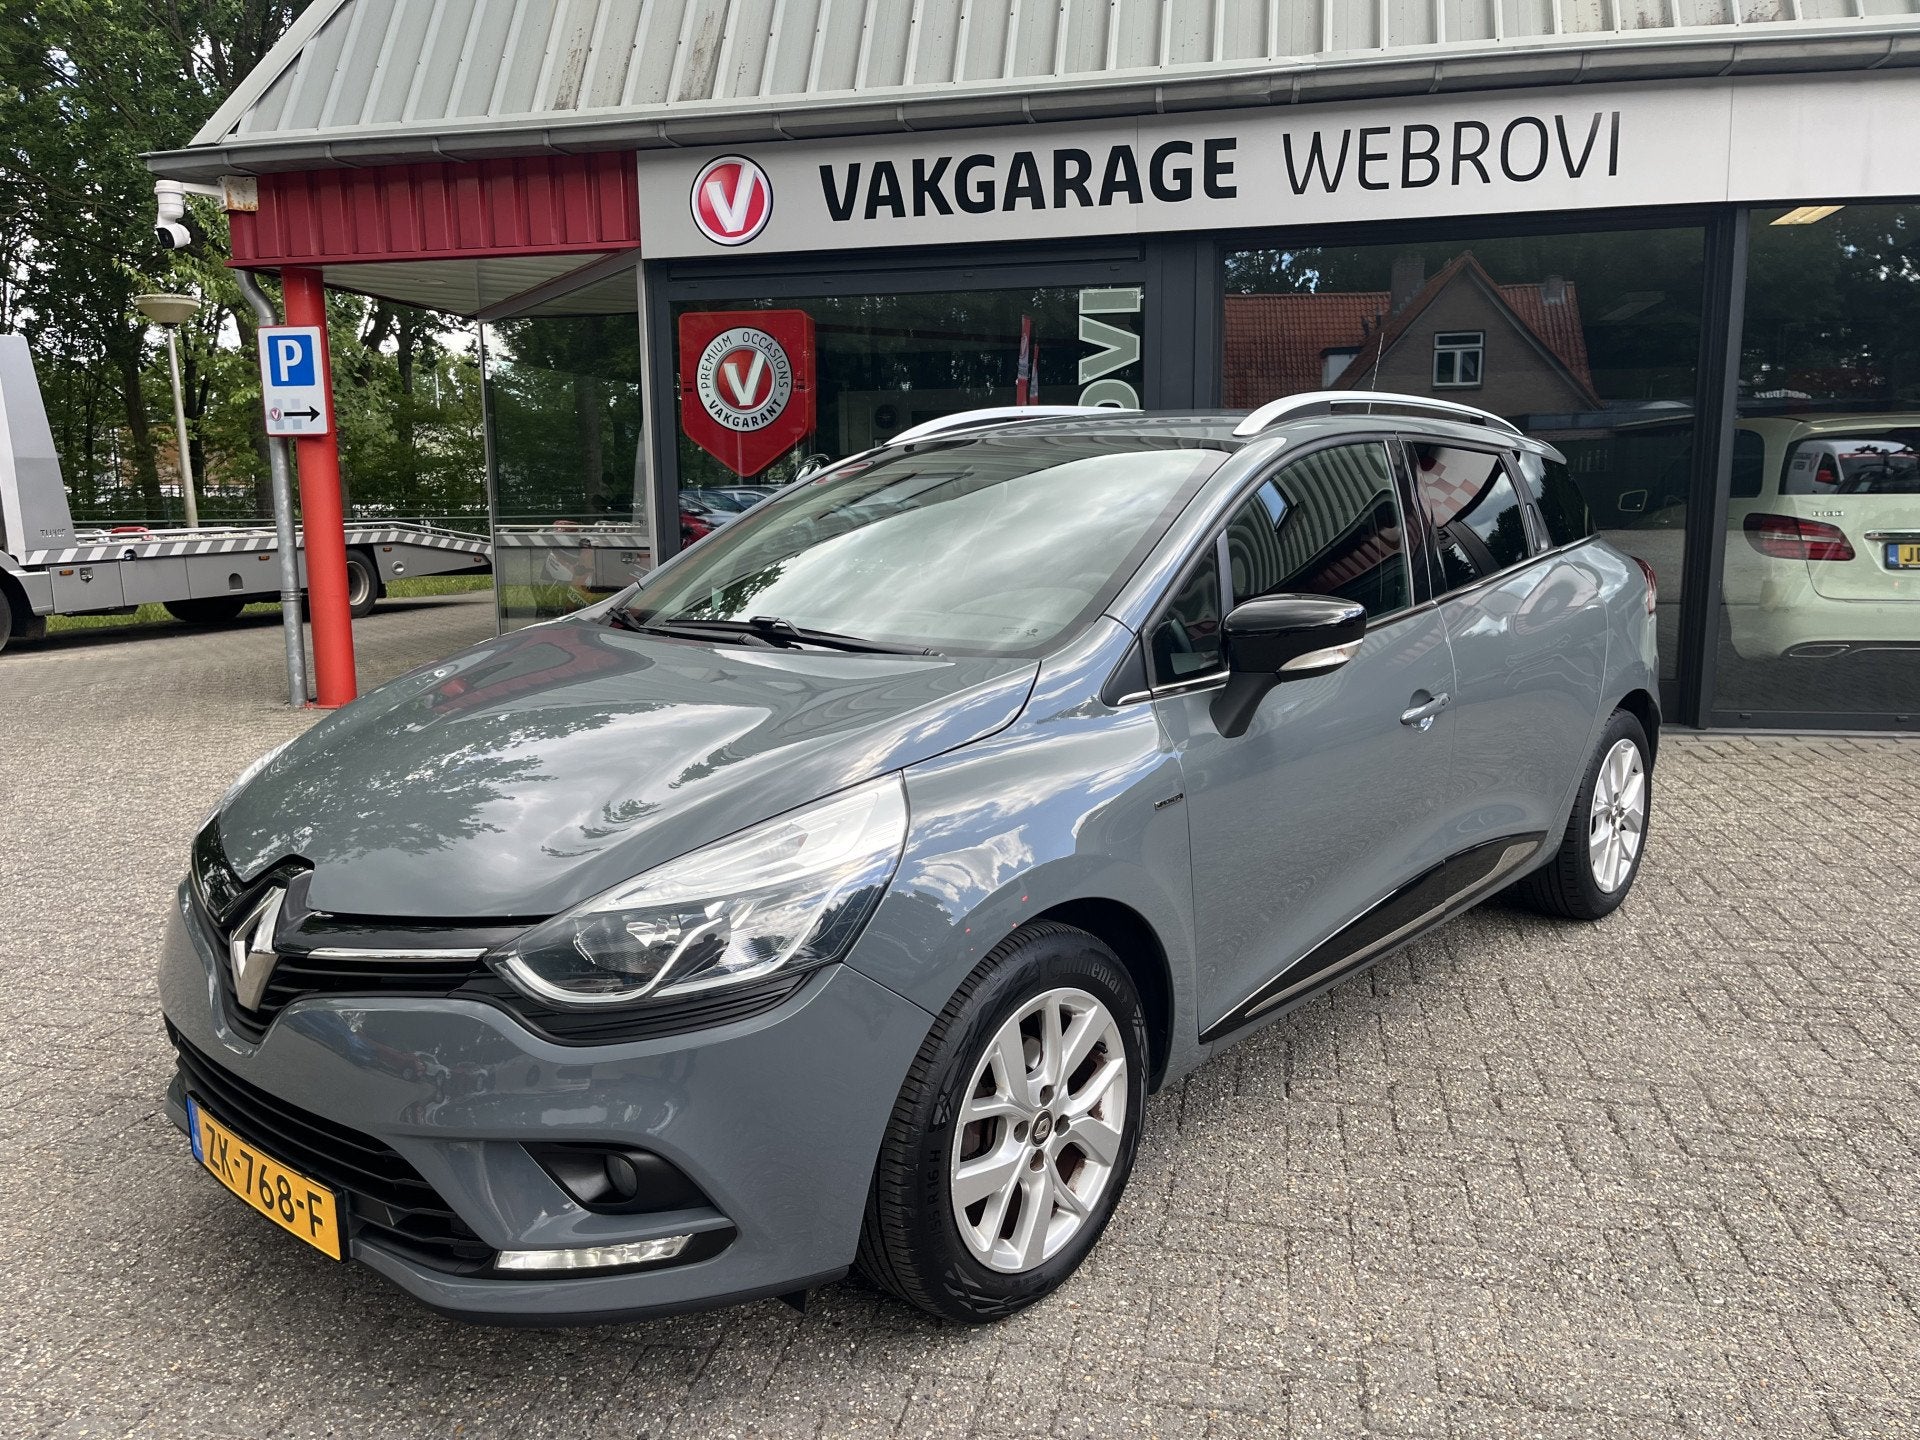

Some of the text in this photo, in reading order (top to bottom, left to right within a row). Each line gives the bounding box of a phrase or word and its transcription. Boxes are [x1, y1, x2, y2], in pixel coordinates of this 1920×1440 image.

[819, 111, 1620, 222] VAKGARAGE WEBROVI
[277, 339, 303, 382] P
[700, 331, 789, 390] PREMIUM OCCASIONS
[708, 398, 783, 429] VAKGARANT
[205, 1121, 324, 1238] ZK-768-F
